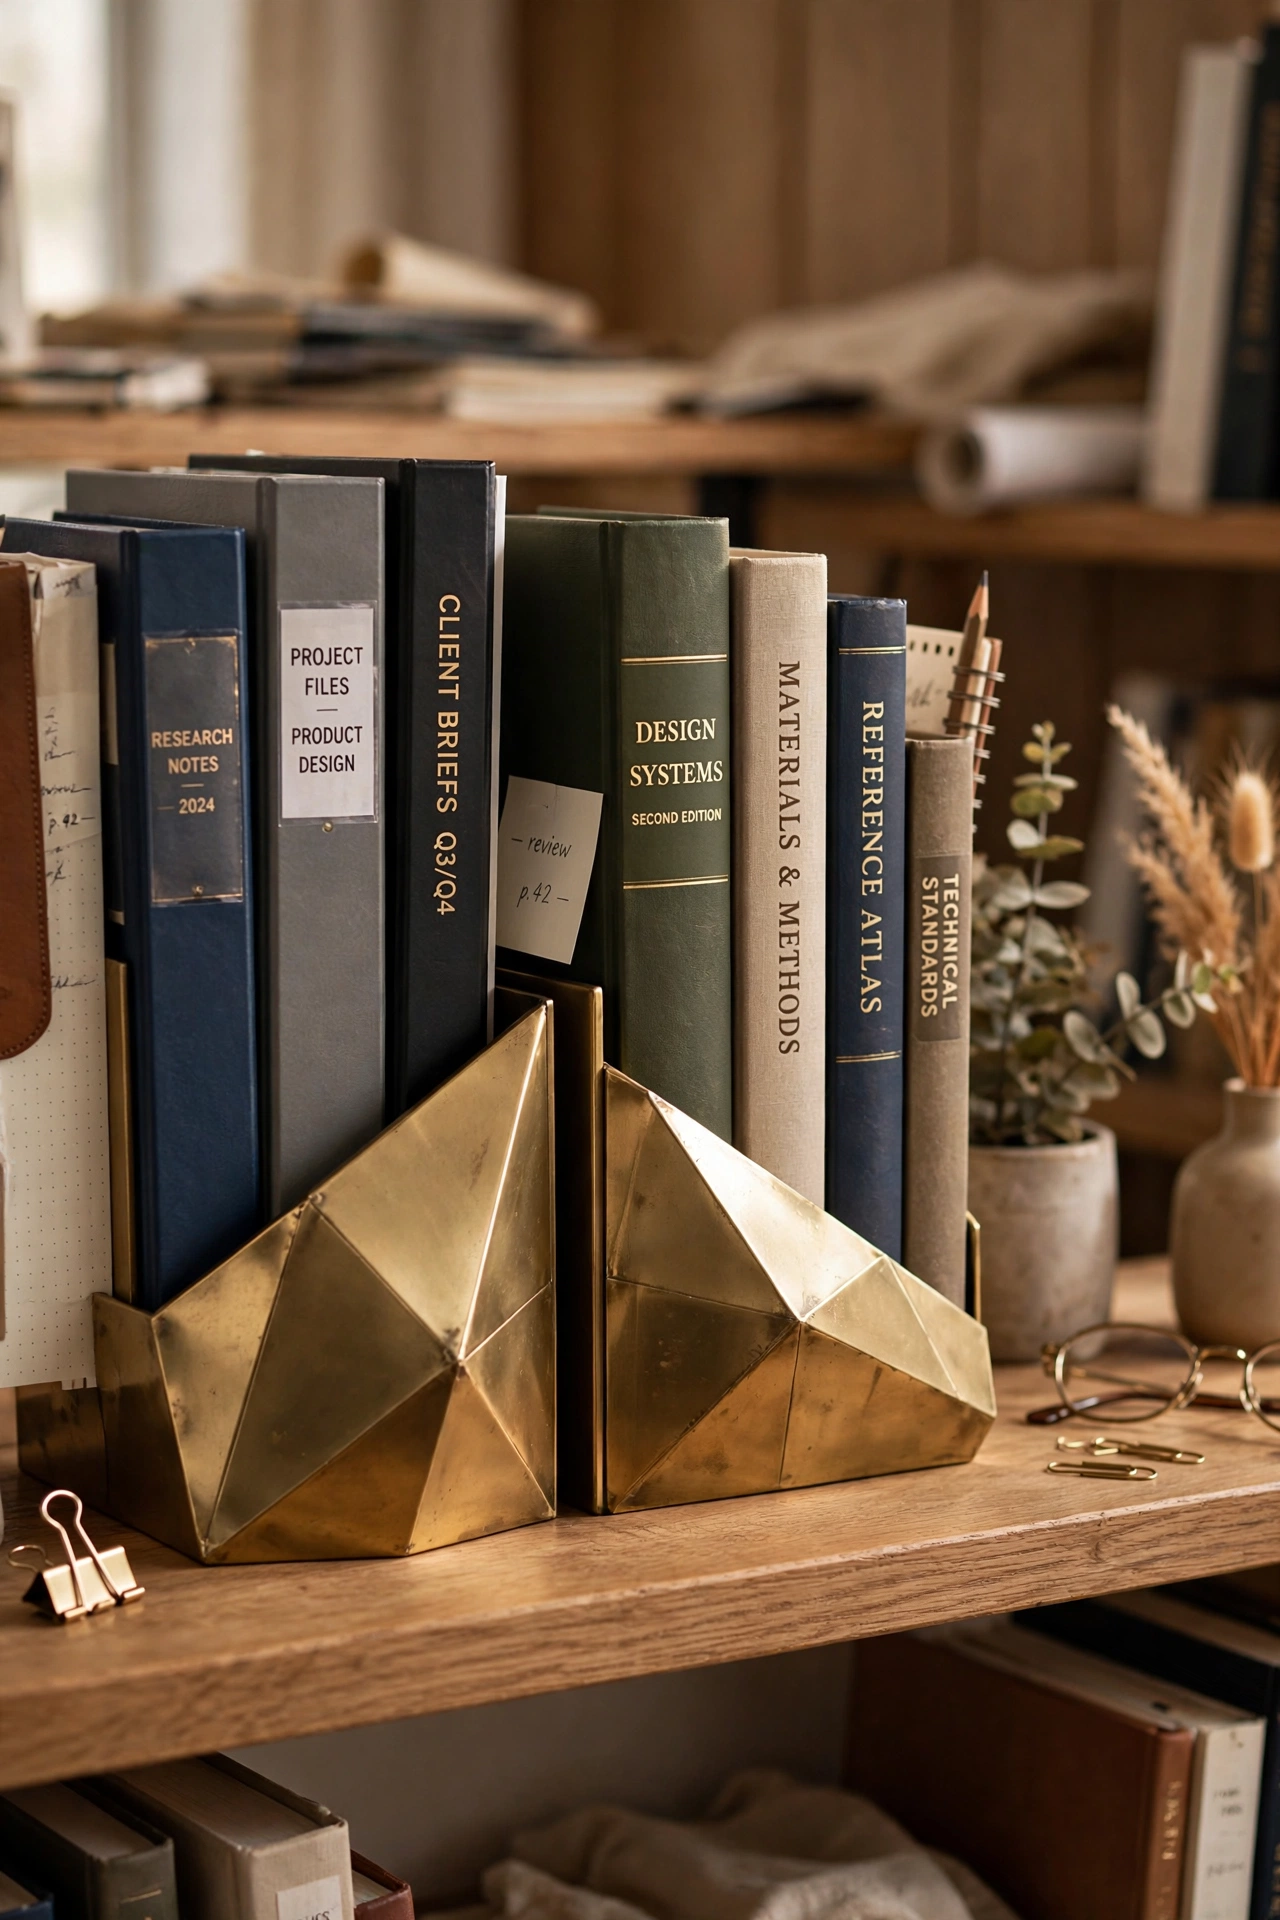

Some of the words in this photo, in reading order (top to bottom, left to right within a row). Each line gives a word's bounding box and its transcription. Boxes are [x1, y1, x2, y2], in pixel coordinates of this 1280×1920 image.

[291, 647, 363, 666] PROJECT
[438, 594, 461, 700] CLIENT
[305, 677, 349, 695] FILES
[151, 728, 233, 748] RESEARCH
[292, 726, 363, 745] PRODUCT
[635, 718, 716, 743] DESIGN
[168, 756, 219, 774] NOTES
[299, 754, 355, 773] DESIGN
[436, 711, 459, 813] BRIEFS
[779, 661, 800, 850] MATERIALS
[630, 761, 723, 787] SYSTEMS
[179, 797, 215, 814] 2024
[861, 701, 884, 896] REFERENCE
[632, 811, 678, 826] SECOND
[681, 808, 722, 823] EDITION
[527, 835, 572, 857] review
[433, 831, 457, 915] Q3/Q4
[779, 866, 800, 888] &
[921, 877, 939, 1017] STANDARDS
[942, 873, 959, 1009] TECHNICAL
[860, 909, 882, 1013] ATLAS
[779, 901, 800, 1054] METHODS
